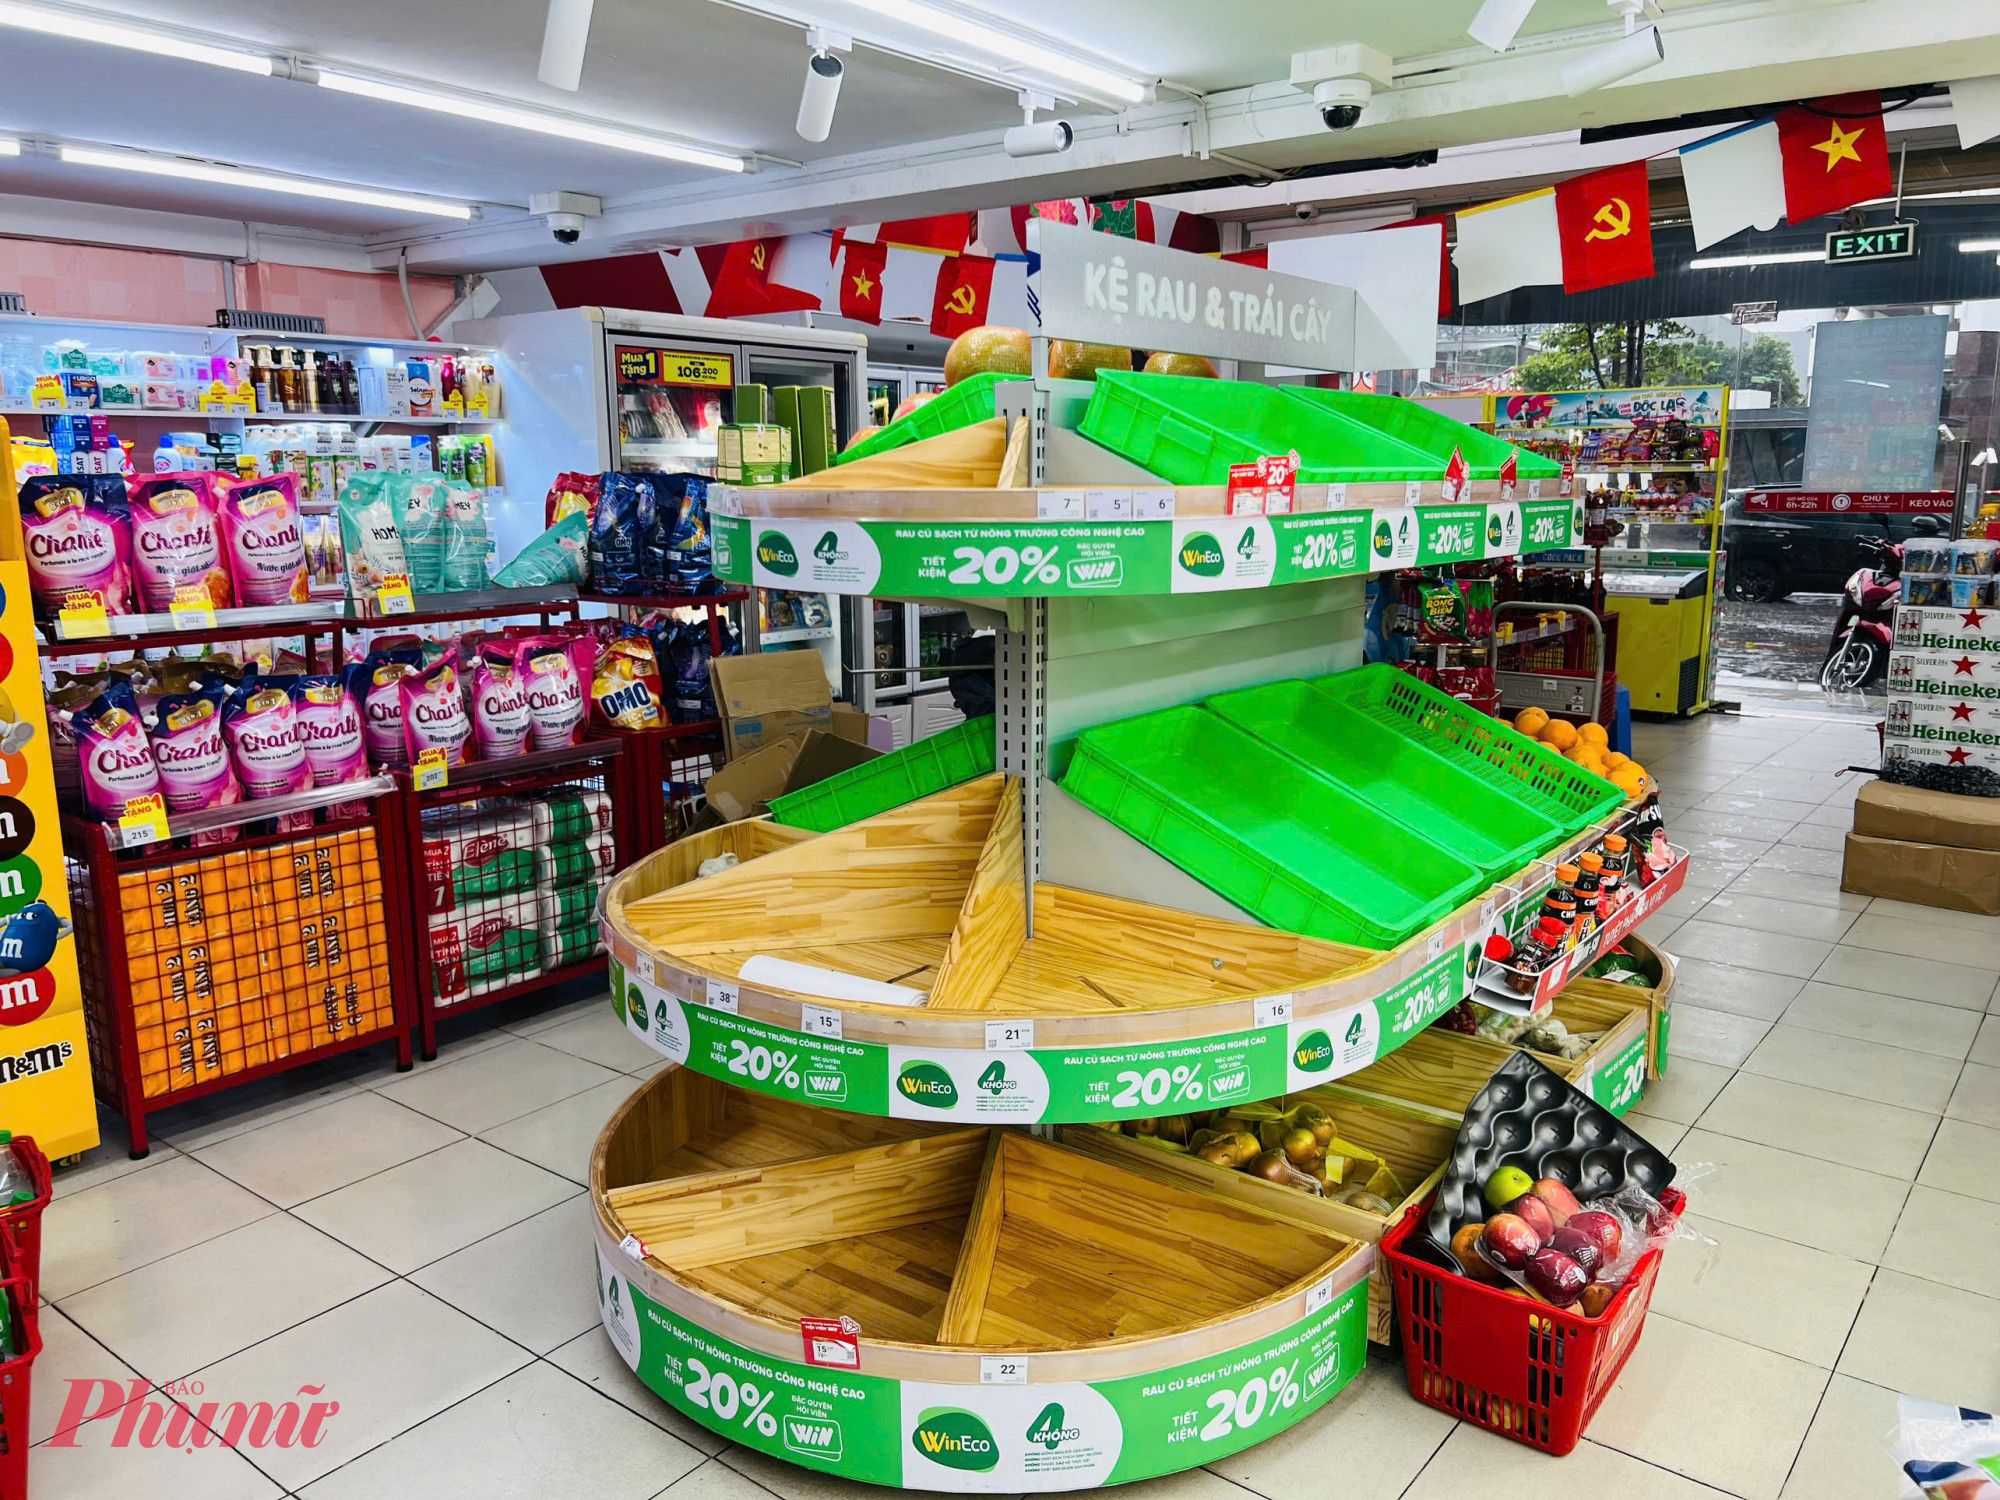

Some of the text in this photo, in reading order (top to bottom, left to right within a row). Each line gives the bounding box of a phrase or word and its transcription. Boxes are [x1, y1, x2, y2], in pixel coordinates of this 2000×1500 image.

[1836, 232, 1904, 256] EXIT
[1084, 257, 1331, 345] KỆ RAU & TRÁI CÂY
[621, 352, 643, 363] Mua
[646, 352, 655, 373] 1
[621, 365, 646, 377] Tặng
[1063, 499, 1071, 509] 7
[1114, 499, 1121, 510] 5
[1159, 499, 1166, 509] 6
[1786, 501, 1817, 509] 6h-22h
[1909, 499, 1953, 507] KÉO VÀO
[895, 526, 1145, 540] RAU CỦ SẠCH TỪ NÔNG TRƯỜNG CÔNG NGHỆ CAO
[1534, 517, 1555, 542] 20%
[615, 538, 632, 547] OMO
[1237, 526, 1255, 560] 4
[1435, 525, 1461, 554] 20%
[760, 546, 794, 563] WinEco
[814, 531, 838, 565] 4
[817, 550, 849, 560] KHÔNG
[1302, 532, 1338, 569] 20%
[1183, 550, 1221, 567] WinEco
[1563, 553, 1582, 562] PACK
[922, 546, 1061, 584] TIẾT 20%
[401, 574, 408, 586] 1
[918, 568, 946, 579] KIỆM
[91, 592, 101, 606] 1
[1916, 657, 1937, 665] SILVER
[1915, 679, 2000, 699] Heineke
[601, 682, 651, 718] OMO
[1914, 703, 1934, 711] SILVER
[421, 748, 446, 760] MUA 1
[1911, 747, 1931, 756] SILVER
[426, 773, 437, 782] 202
[127, 794, 162, 809] MUA 1
[132, 831, 148, 840] 215
[442, 846, 449, 855] 2
[462, 837, 508, 859] Elène
[179, 874, 196, 887] 2
[156, 881, 173, 896] 2
[434, 885, 445, 907] 1
[302, 924, 316, 938] 2
[189, 946, 206, 960] 2
[166, 954, 182, 969] 2
[644, 963, 650, 973] 14
[720, 992, 731, 1003] 38
[1272, 1005, 1284, 1016] 16
[1403, 981, 1435, 1032] 20%
[820, 1016, 832, 1027] 15
[697, 1012, 709, 1021] RAU
[719, 1018, 736, 1031] SẠCH
[747, 1026, 767, 1039] NÔNG
[767, 1029, 798, 1046] TRƯỜNG
[799, 1037, 821, 1049] CÔNG
[822, 1041, 845, 1055] NGHỆ
[847, 1047, 864, 1056] CAO
[1005, 1030, 1019, 1039] 21
[1345, 1013, 1362, 1045] 4
[710, 1051, 727, 1064] KIỆM
[1064, 1036, 1267, 1065] RAU CỦ SẠCH TỪ NÔNG TRƯỜNG CÔNG NGHỆ CAO
[1297, 1046, 1330, 1066] WinEco
[712, 1039, 800, 1089] TIẾT 20%
[977, 1060, 1005, 1096] 4
[982, 1079, 1017, 1090] KHÔNG
[1088, 1062, 1203, 1108] TIẾT 20%
[901, 1077, 952, 1095] WinEco
[1085, 1093, 1110, 1104] KIỆM
[1318, 1288, 1327, 1300] 19
[648, 1309, 661, 1326] RAU
[661, 1314, 672, 1332] CỦ
[673, 1324, 694, 1348] SẠCH
[706, 1344, 732, 1364] NÔNG
[733, 1355, 774, 1378] TRƯỜNG
[775, 1370, 805, 1388] CÔNG
[807, 1379, 839, 1398] NGHỆ
[841, 1387, 865, 1400] CAO
[1142, 1298, 1354, 1398] RAU CỦ SẠCH TỪ NÔNG TRƯỜNG CÔNG NGHỆ CAO
[1000, 1364, 1016, 1375] 22
[664, 1367, 684, 1387] KIỆM
[665, 1353, 778, 1437] TIẾT 20%
[791, 1394, 806, 1404] ĐẶC
[1172, 1358, 1299, 1442] TIẾT 20%
[796, 1405, 827, 1418] HỘI VIÊN
[1026, 1402, 1065, 1450] 4
[919, 1429, 991, 1454] WinEco
[1033, 1428, 1080, 1442] KHÔNG
[1167, 1425, 1198, 1444] KIỆM
